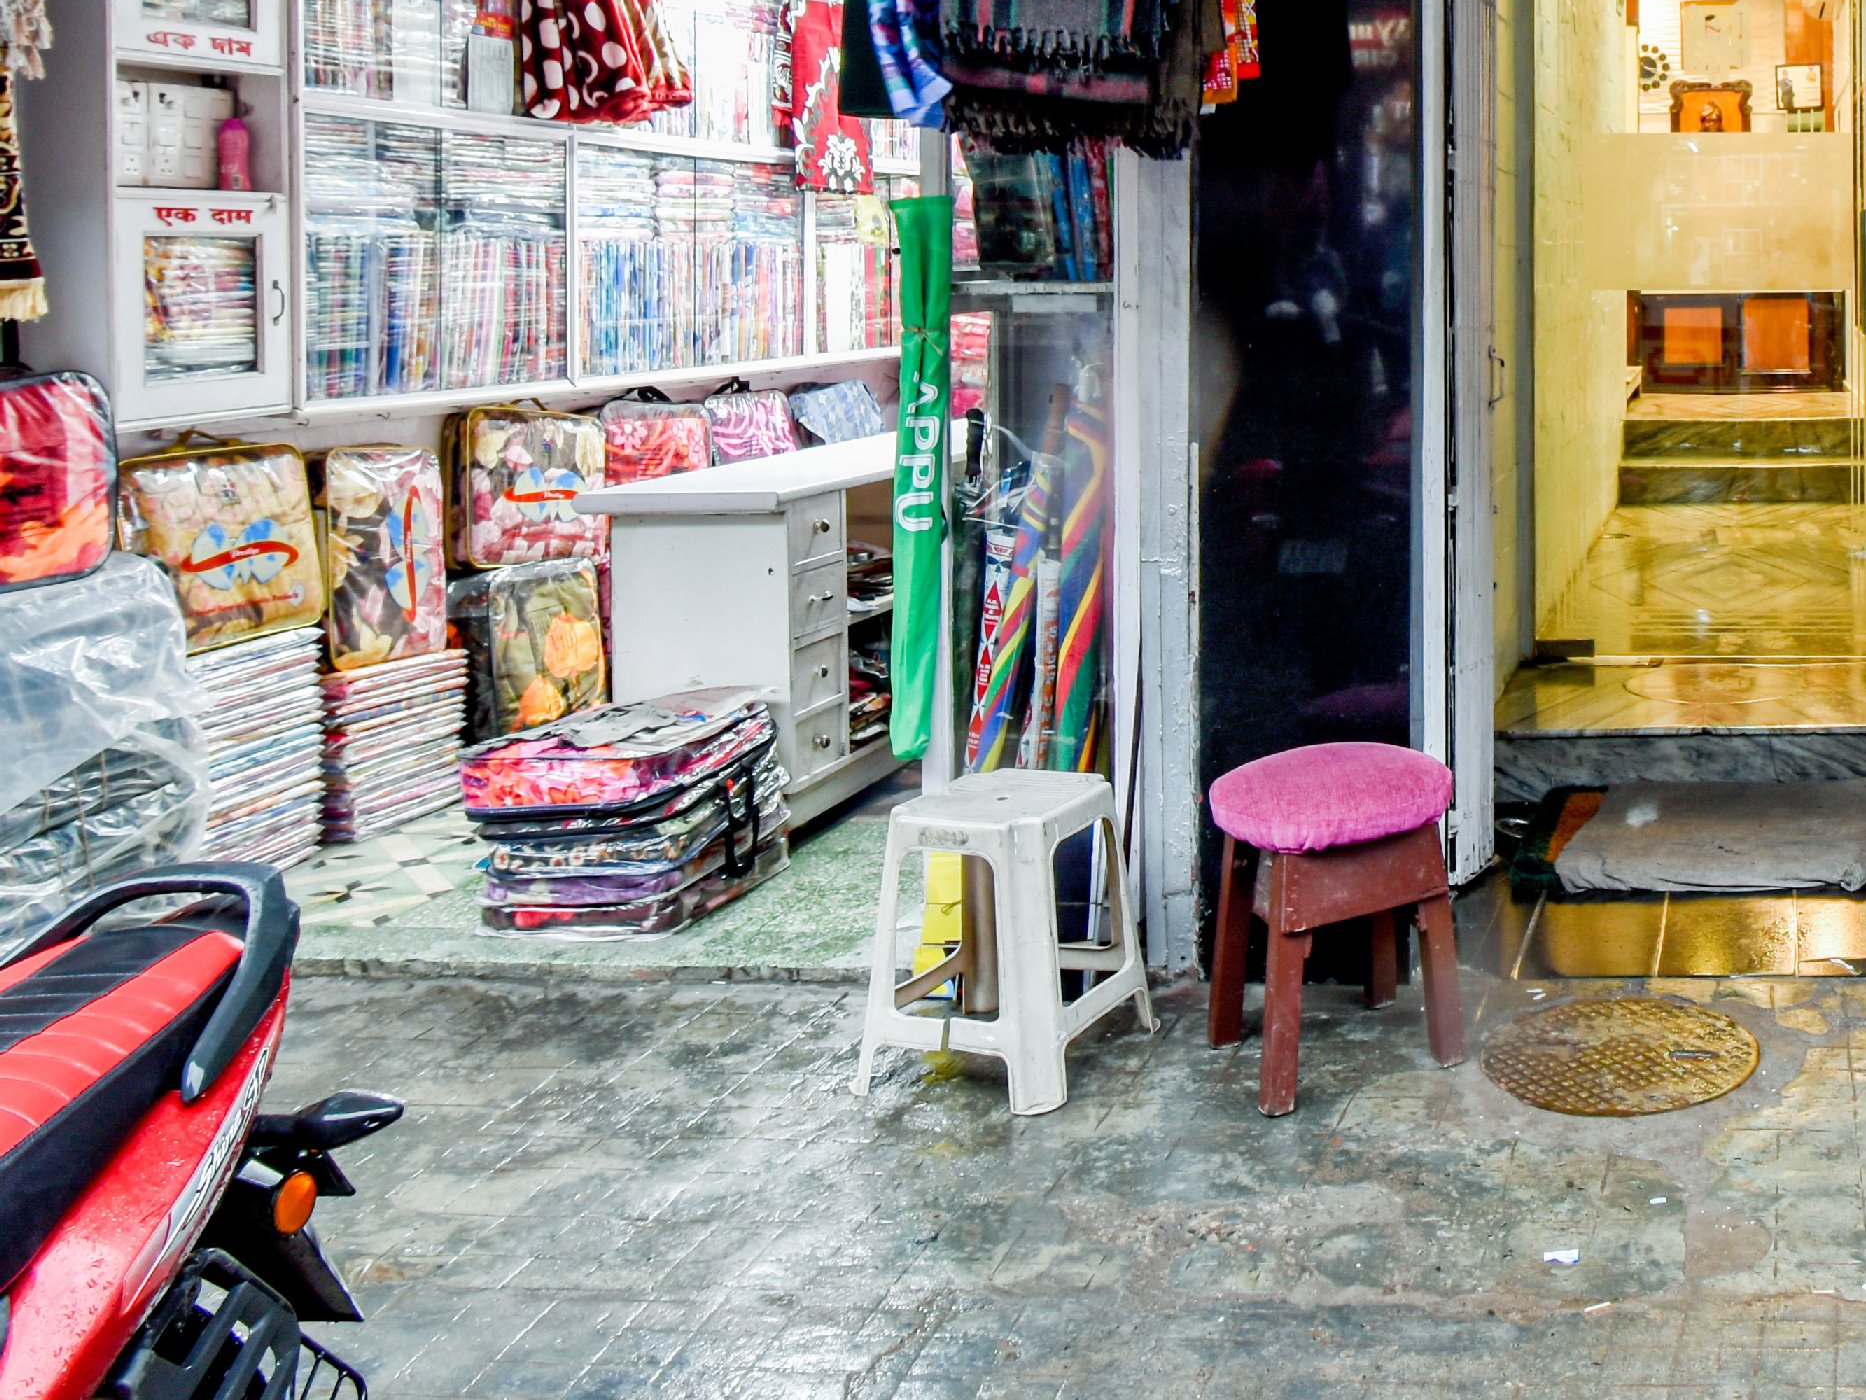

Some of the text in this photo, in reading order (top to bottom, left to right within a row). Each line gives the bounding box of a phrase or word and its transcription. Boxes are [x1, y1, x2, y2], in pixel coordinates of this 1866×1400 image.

[146, 30, 253, 57] এক দাম
[153, 206, 253, 227] एक दाम
